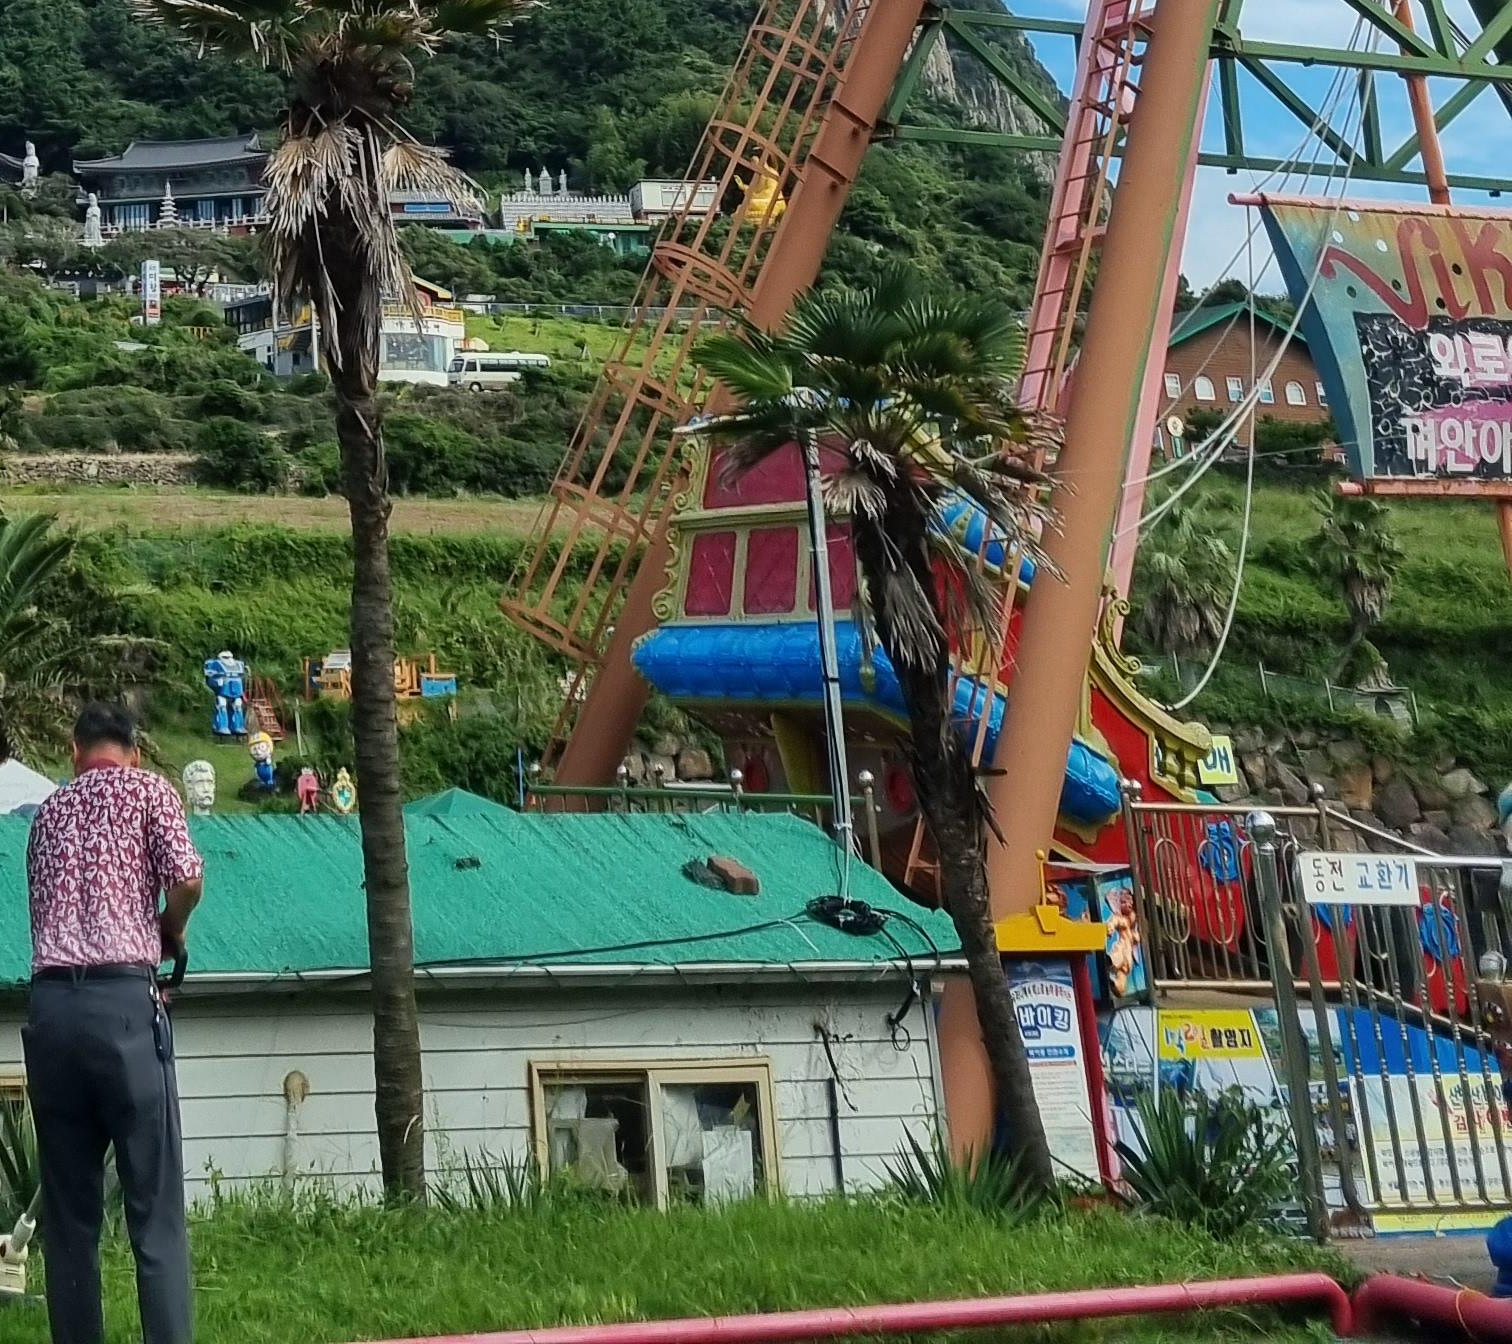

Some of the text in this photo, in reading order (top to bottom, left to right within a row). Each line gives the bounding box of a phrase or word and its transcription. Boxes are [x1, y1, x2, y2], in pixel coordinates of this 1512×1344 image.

[1428, 331, 1512, 388] 외로
[1312, 858, 1410, 893] 동전 교환기
[1018, 1005, 1070, 1031] 바이킹
